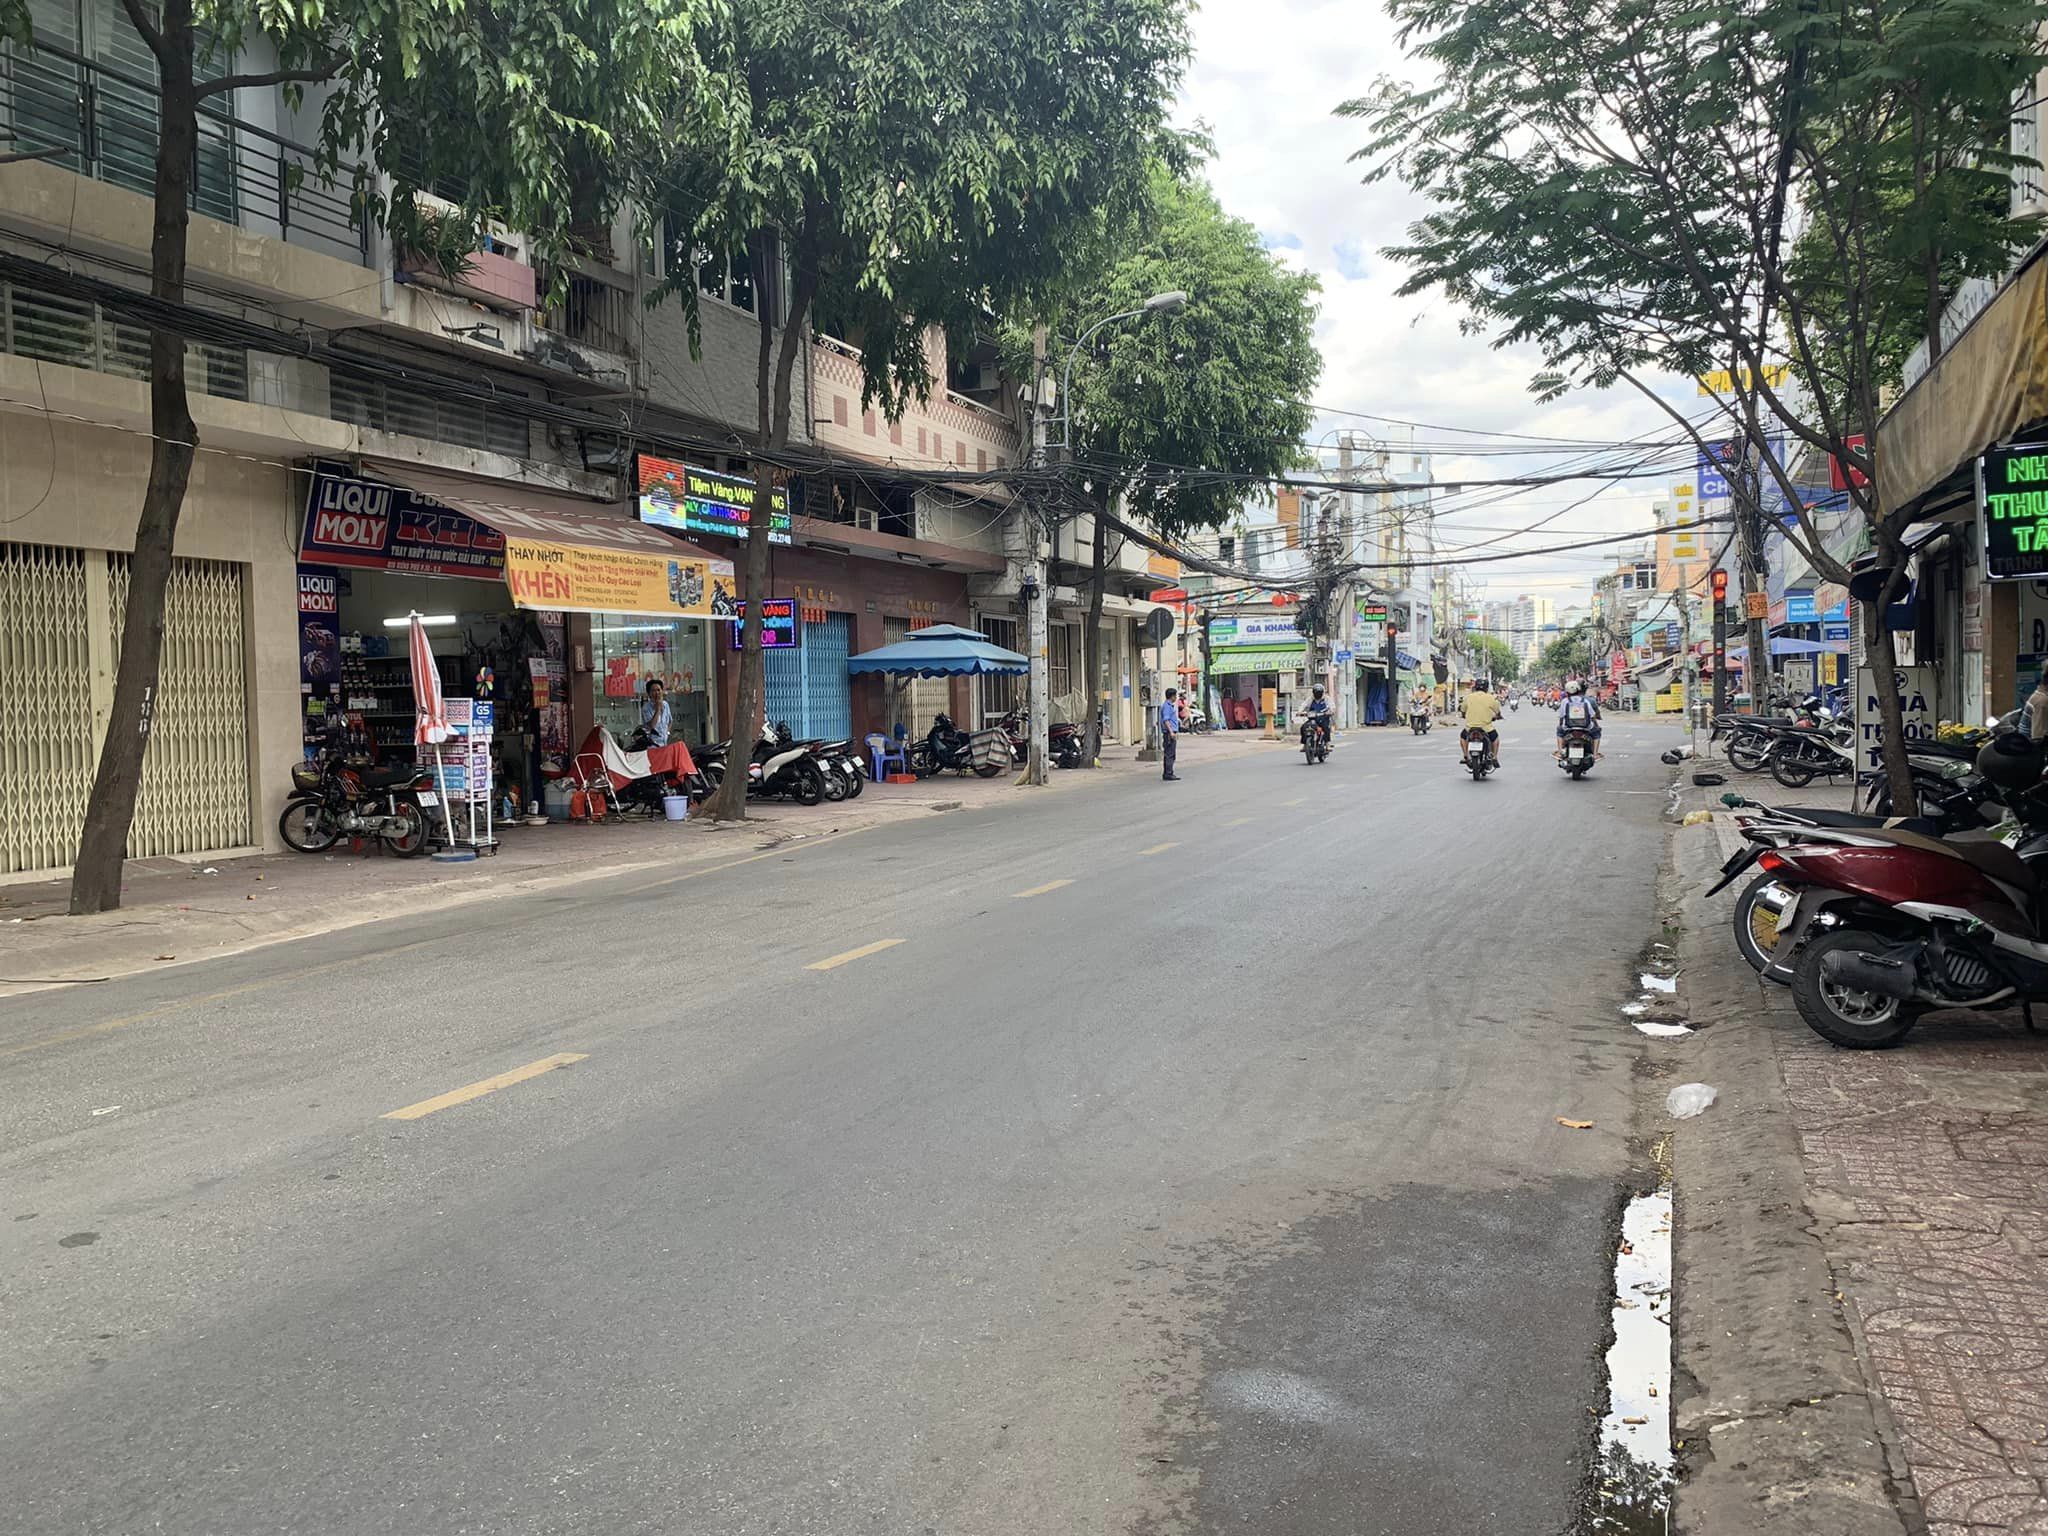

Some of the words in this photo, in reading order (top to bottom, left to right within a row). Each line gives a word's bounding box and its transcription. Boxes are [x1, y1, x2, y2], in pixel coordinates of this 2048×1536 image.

[688, 476, 711, 495] Tiệm
[323, 482, 389, 516] LIQUI
[319, 514, 386, 545] MOLY
[509, 547, 535, 561] THAY
[537, 548, 565, 563] NHỚT
[300, 577, 334, 594] LIQUI
[301, 593, 335, 610] MOLY
[1246, 624, 1261, 632] GIA
